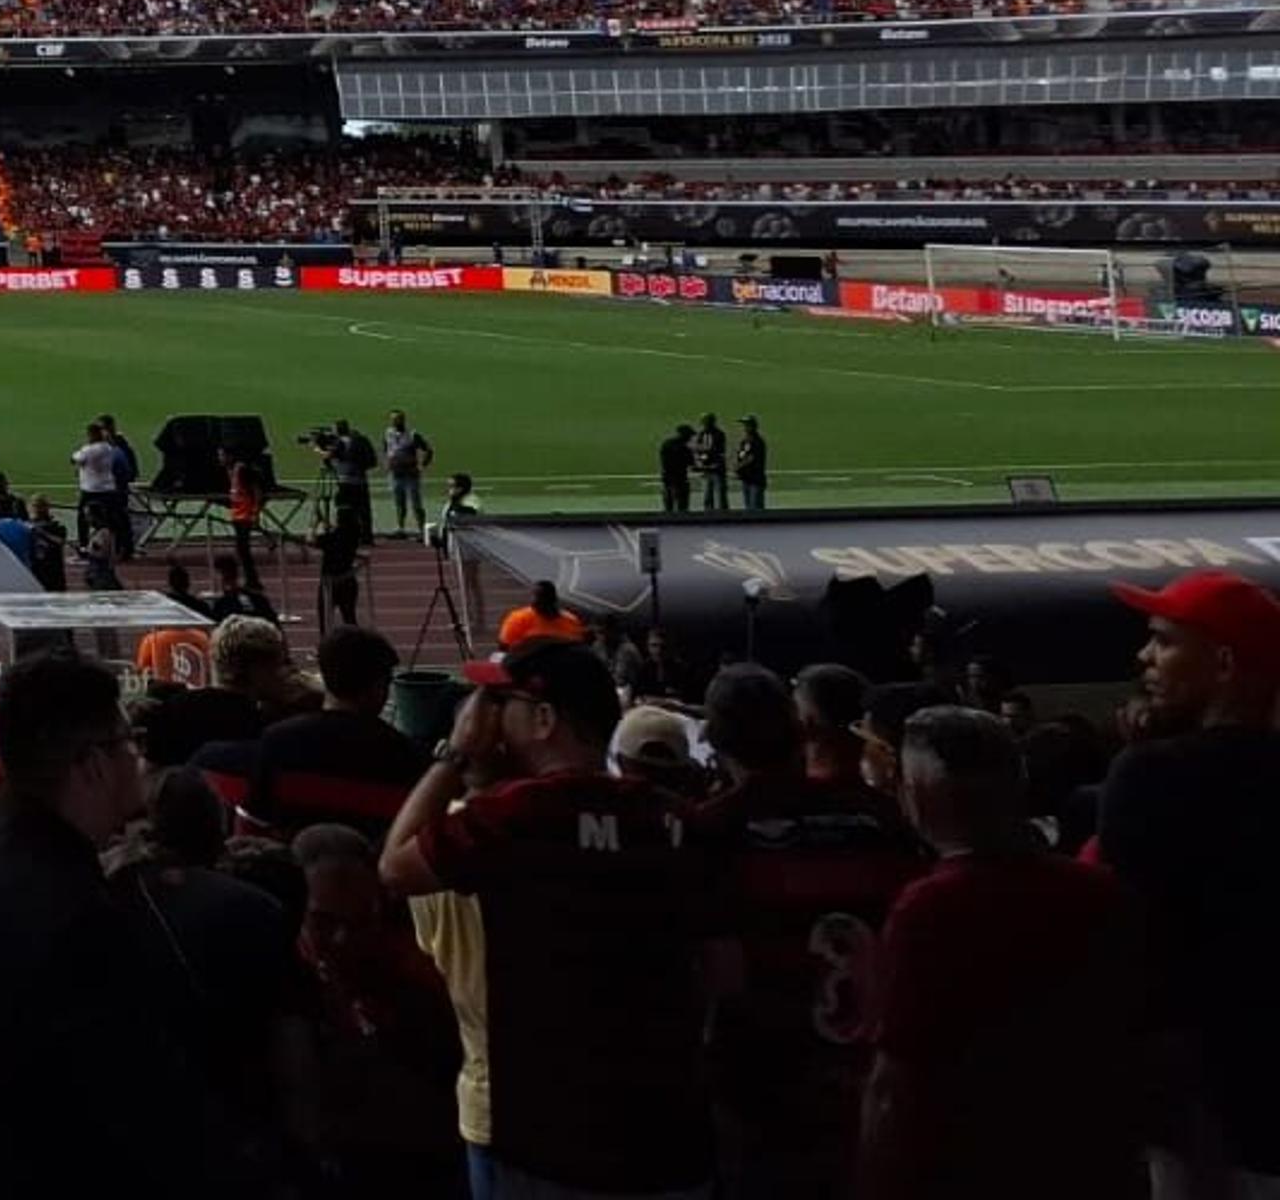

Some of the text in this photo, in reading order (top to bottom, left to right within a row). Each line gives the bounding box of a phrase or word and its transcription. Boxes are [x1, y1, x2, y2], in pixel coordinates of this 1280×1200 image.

[35, 43, 64, 56] CBF
[338, 267, 463, 288] SUPERBET
[872, 284, 944, 312] Betano
[811, 537, 1264, 577] SUPERCOPA
